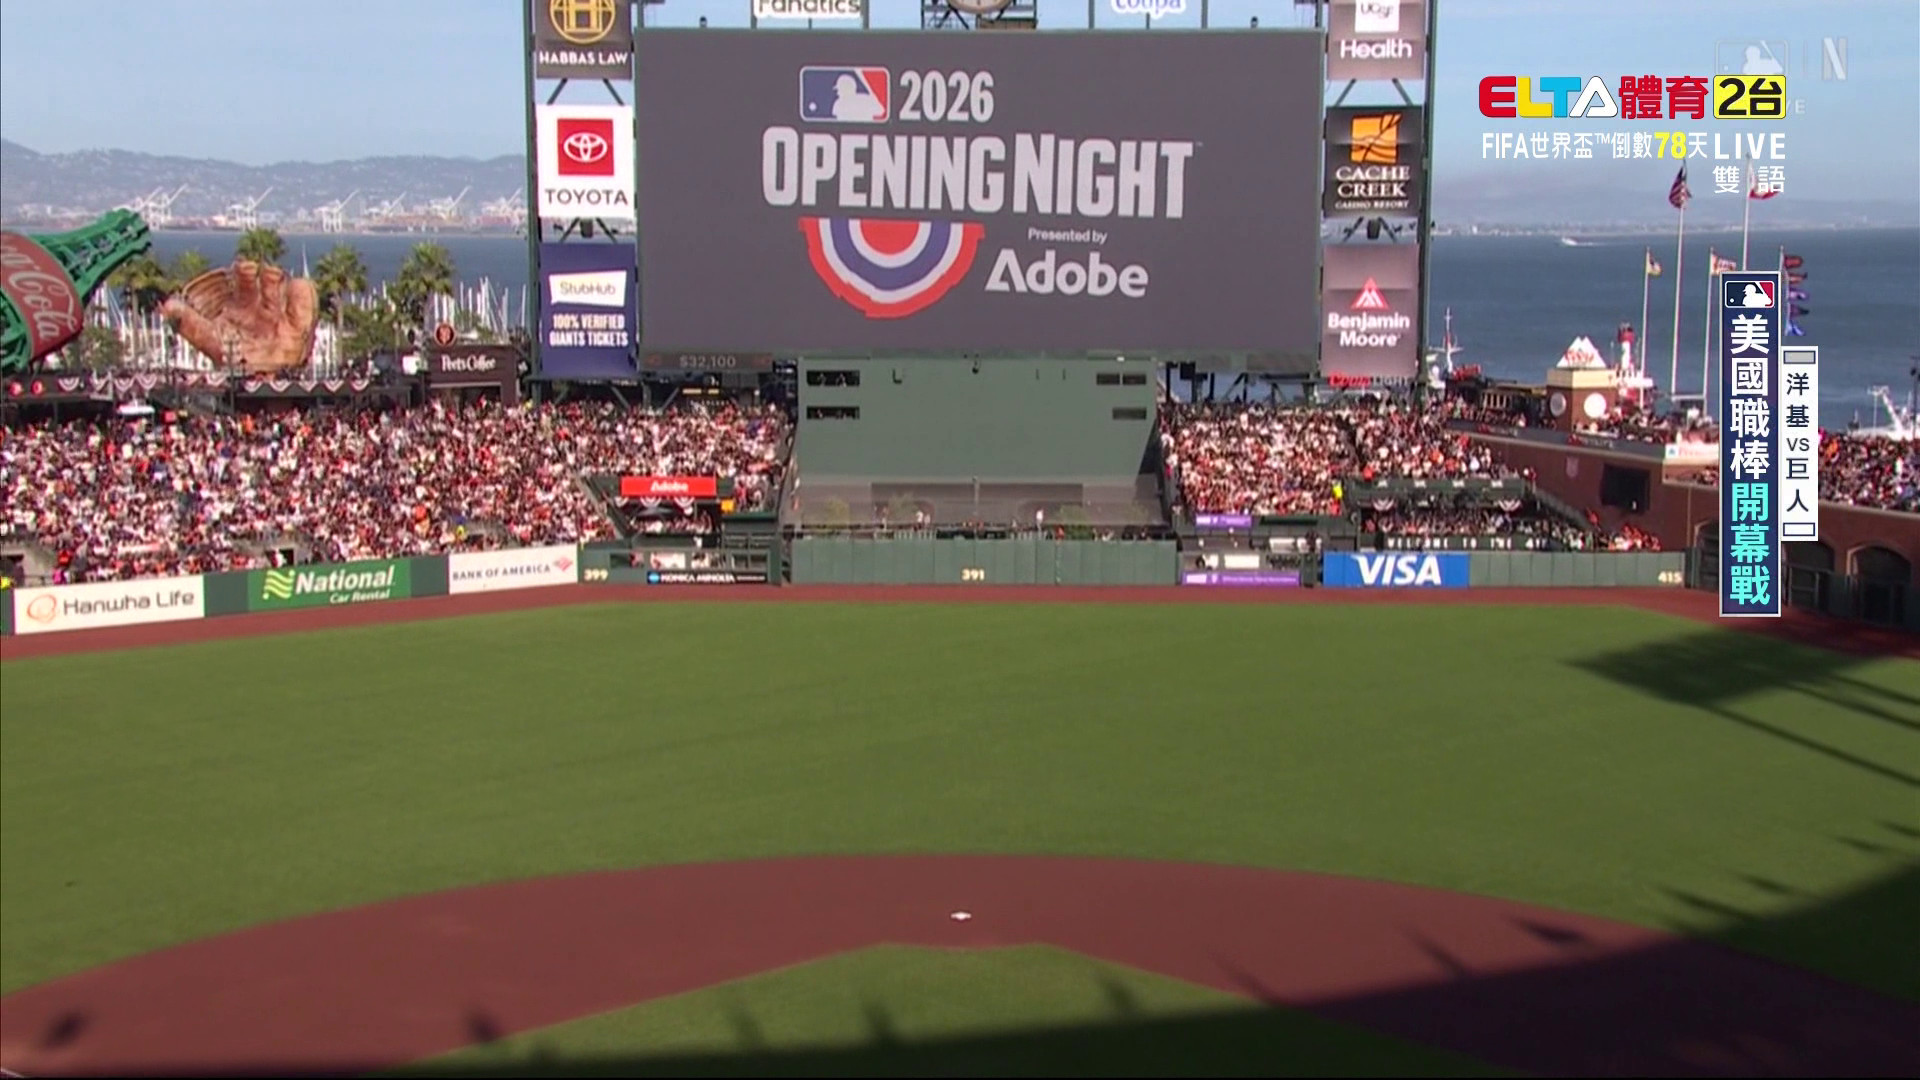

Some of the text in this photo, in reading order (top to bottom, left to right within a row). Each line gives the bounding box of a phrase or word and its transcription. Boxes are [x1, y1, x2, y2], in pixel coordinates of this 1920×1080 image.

[1339, 39, 1412, 60] Health
[539, 52, 628, 65] HABBAS LAW
[900, 71, 995, 122] 2026
[762, 126, 1194, 219] OPENING NIGHT
[1335, 166, 1411, 181] CACHE
[545, 188, 628, 206] TOYOTA
[1337, 182, 1407, 198] CREEK
[1028, 228, 1108, 244] Presented by
[984, 248, 1149, 297] Adobe
[560, 281, 616, 296] StubHub
[552, 314, 625, 330] 100% VERIFIED
[1328, 312, 1411, 332] Benjamin
[550, 332, 628, 347] GIANTS TICKETS
[1340, 331, 1398, 347] Moore
[467, 354, 496, 371] Coffee
[650, 480, 689, 493] Adobe
[452, 564, 551, 581] BANK OF AMERICA
[961, 568, 985, 581] 391
[1351, 554, 1442, 586] VISA
[296, 564, 395, 595] National
[63, 590, 194, 616] Hanwha Life
[330, 589, 390, 604] Car Rental
